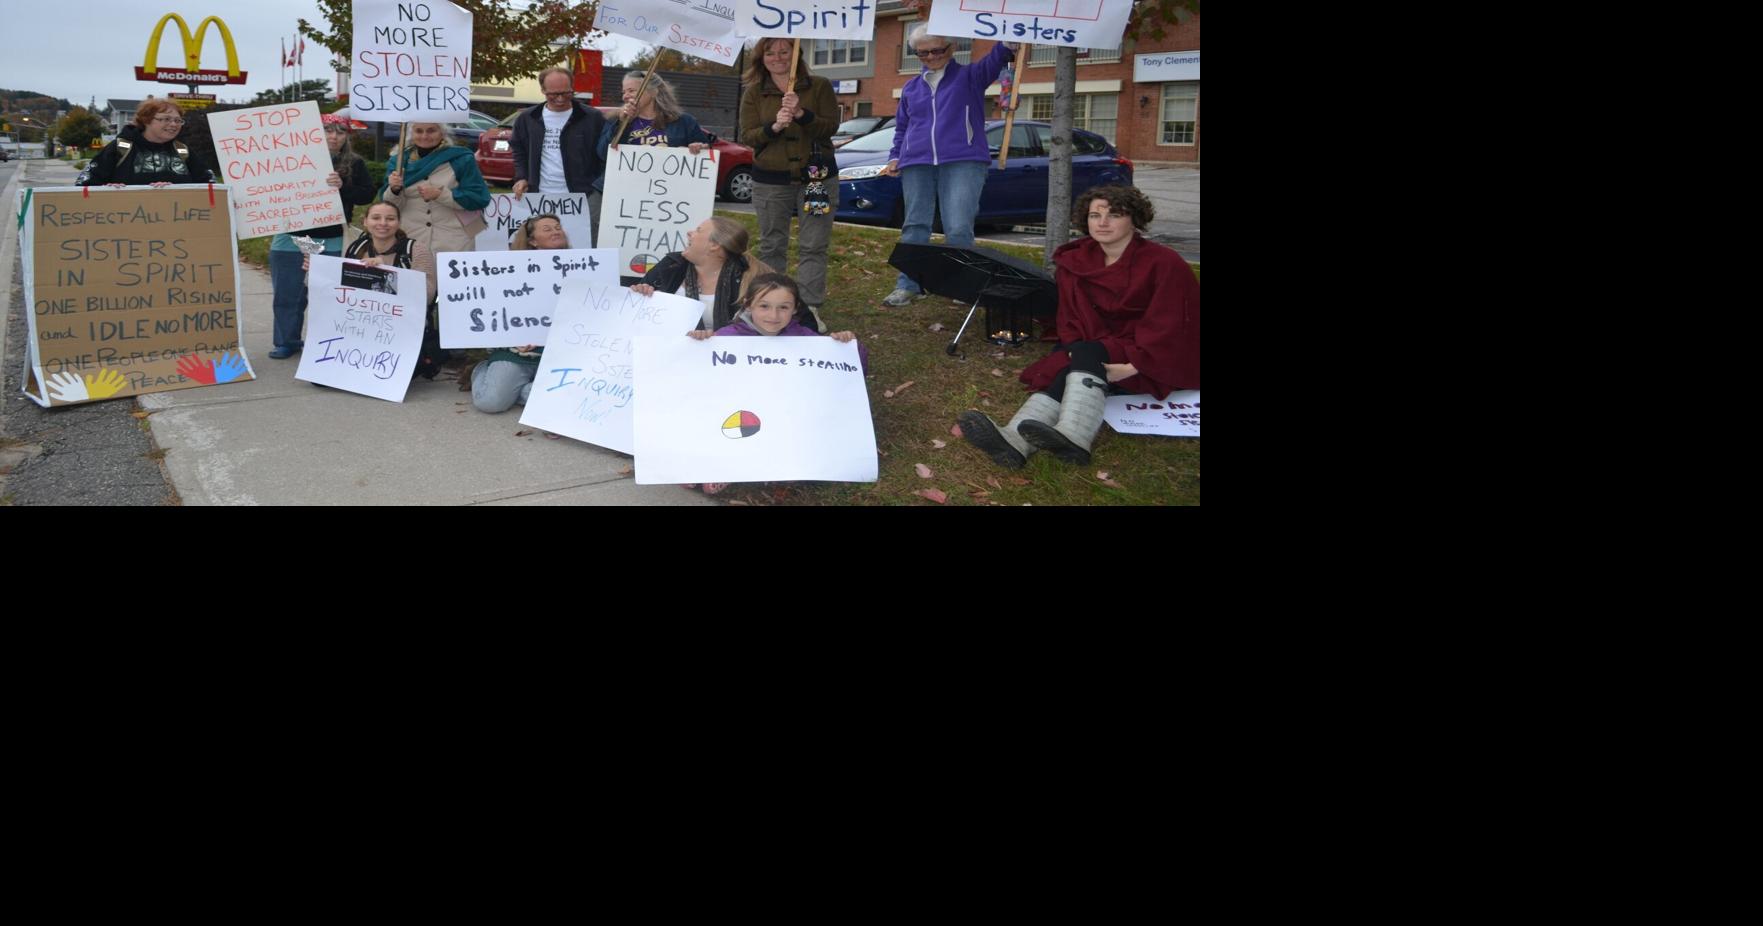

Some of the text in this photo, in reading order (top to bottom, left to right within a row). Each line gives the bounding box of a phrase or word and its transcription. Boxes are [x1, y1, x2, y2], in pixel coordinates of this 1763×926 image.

[398, 3, 431, 22] NO
[753, 0, 870, 33] Spirit
[374, 26, 448, 48] MORE
[599, 5, 732, 58] FOR OUR SISTERS
[974, 12, 1077, 43] Sisters
[359, 50, 469, 79] STOLEN
[1142, 57, 1163, 67] Tony
[157, 71, 228, 82] McDonald's
[353, 83, 470, 112] SISTERS
[235, 108, 301, 131] STOP
[218, 128, 322, 156] FRACKING
[228, 154, 317, 180] CANADA
[619, 151, 711, 179] NO ONE
[246, 180, 317, 196] SOLIDARITY
[648, 179, 668, 196] IS
[41, 202, 211, 227] RESPECT ALL LIFE
[246, 201, 333, 223] SACRED FIRE
[485, 194, 583, 218] 00 WOMEN
[620, 199, 690, 224] LESS
[251, 214, 343, 236] IDLE NO MORE
[60, 239, 189, 261] SISTERS
[58, 263, 223, 287] IN SPIRIT
[448, 255, 600, 279] Sisters in Spirit
[34, 288, 233, 316] ONE BILLION RISING
[334, 287, 403, 317] JUSTICE
[447, 286, 486, 302] will
[503, 282, 535, 298] not
[41, 309, 237, 341] and IDLE NO MORE
[345, 309, 394, 331] STARTS
[469, 307, 552, 332] Silenc
[334, 319, 396, 345] WITH AN
[45, 354, 96, 373] ONE
[97, 348, 161, 368] PEOPLE
[161, 348, 189, 360] ONE
[315, 337, 402, 380] INQUIRY
[712, 351, 737, 366] No
[126, 371, 186, 391] PEACE
